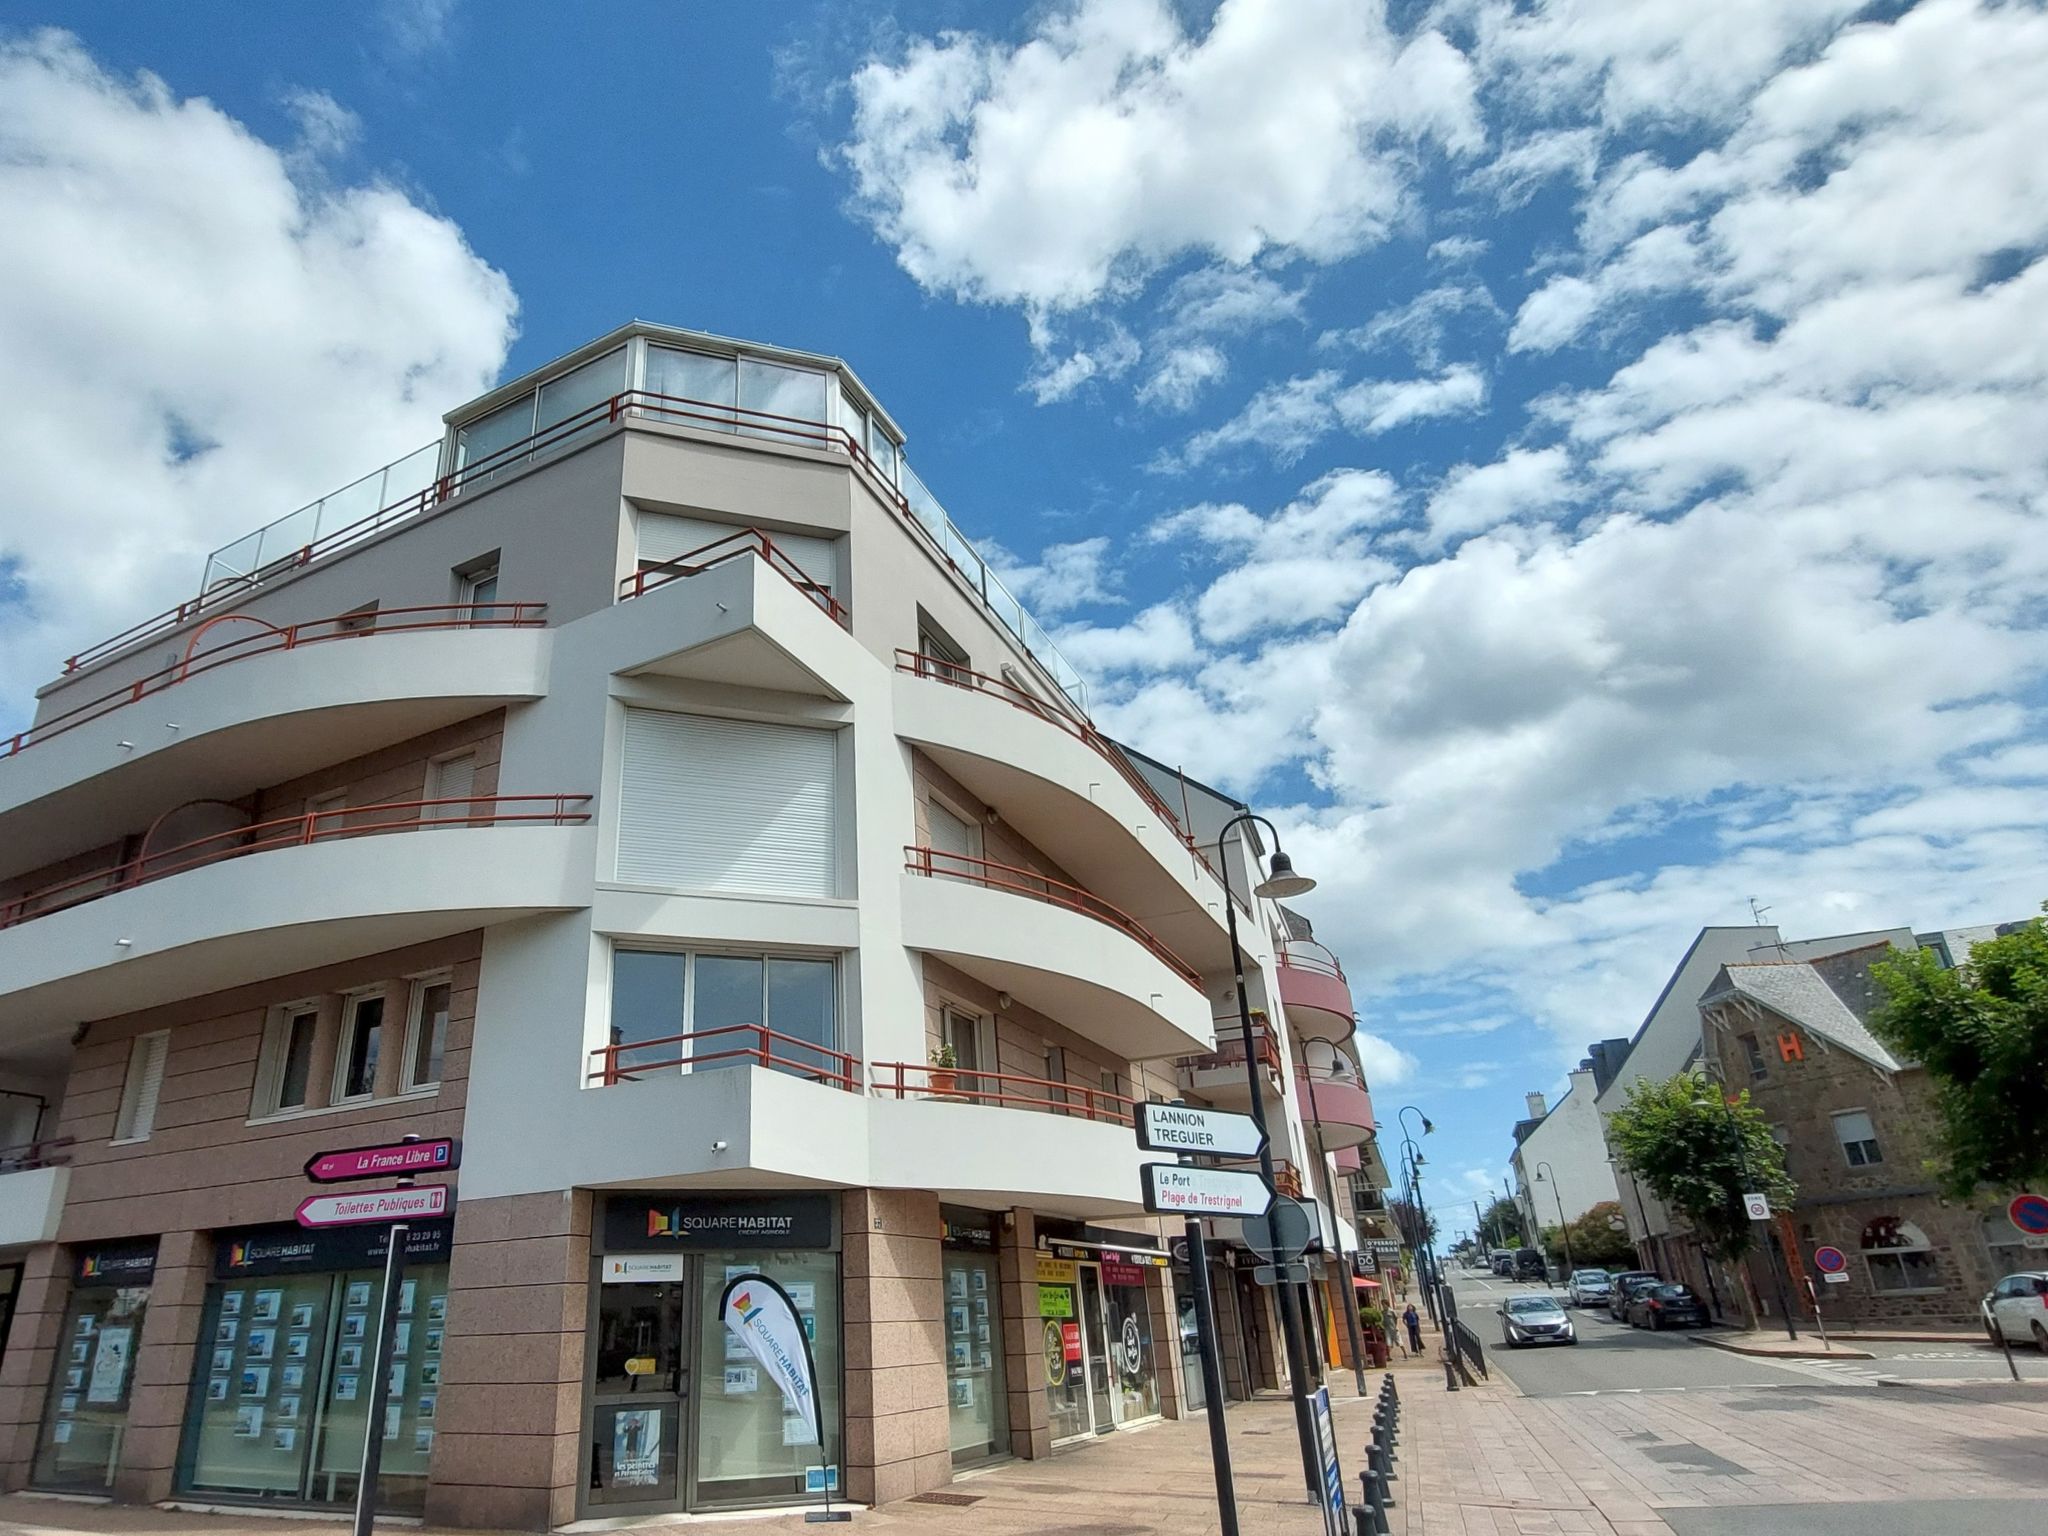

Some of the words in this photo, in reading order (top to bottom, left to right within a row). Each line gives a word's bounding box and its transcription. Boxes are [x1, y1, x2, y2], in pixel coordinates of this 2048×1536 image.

[1776, 1031, 1805, 1063] H
[1152, 1109, 1205, 1127] LANNION
[1154, 1128, 1215, 1146] TREGUIER
[356, 1156, 368, 1170] La
[370, 1154, 403, 1168] France
[405, 1150, 431, 1164] Libre
[1159, 1173, 1169, 1185] Le
[1172, 1173, 1191, 1187] Port
[334, 1202, 375, 1216] Toilettes
[376, 1197, 425, 1213] Publiques
[1161, 1190, 1186, 1206] Plage
[1188, 1190, 1198, 1204] de
[1200, 1192, 1243, 1209] Trestrignel
